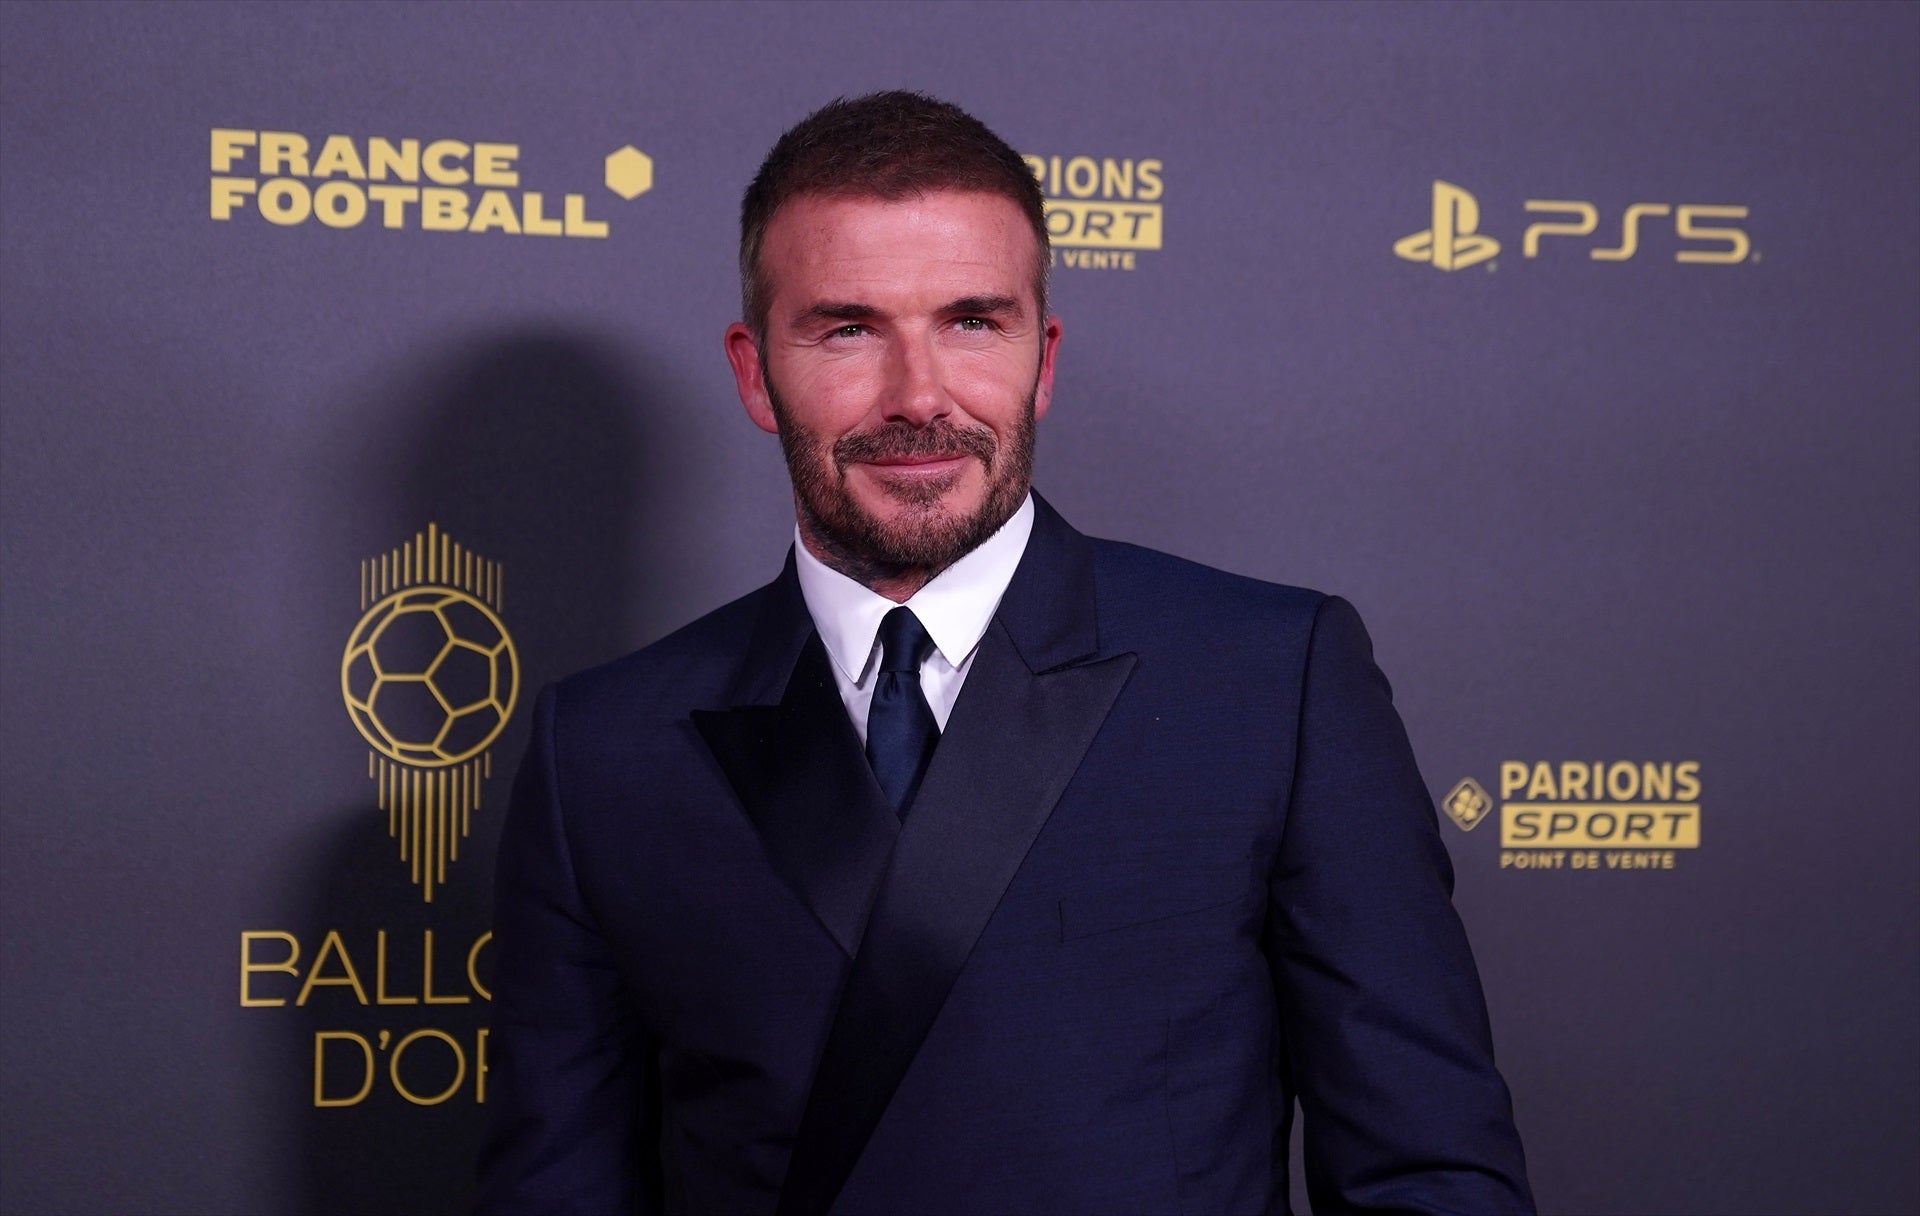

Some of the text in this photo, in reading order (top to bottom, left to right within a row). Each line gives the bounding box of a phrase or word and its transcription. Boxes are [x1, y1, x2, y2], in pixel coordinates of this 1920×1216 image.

[210, 128, 519, 187] FRANCE
[210, 177, 609, 237] FOOTBALL
[1523, 201, 1750, 264] PS5
[1062, 251, 1136, 270] VENTE
[1501, 761, 1700, 801] PARIONS
[1511, 812, 1692, 841] SPORT
[1501, 852, 1675, 869] POINT DE VENTE
